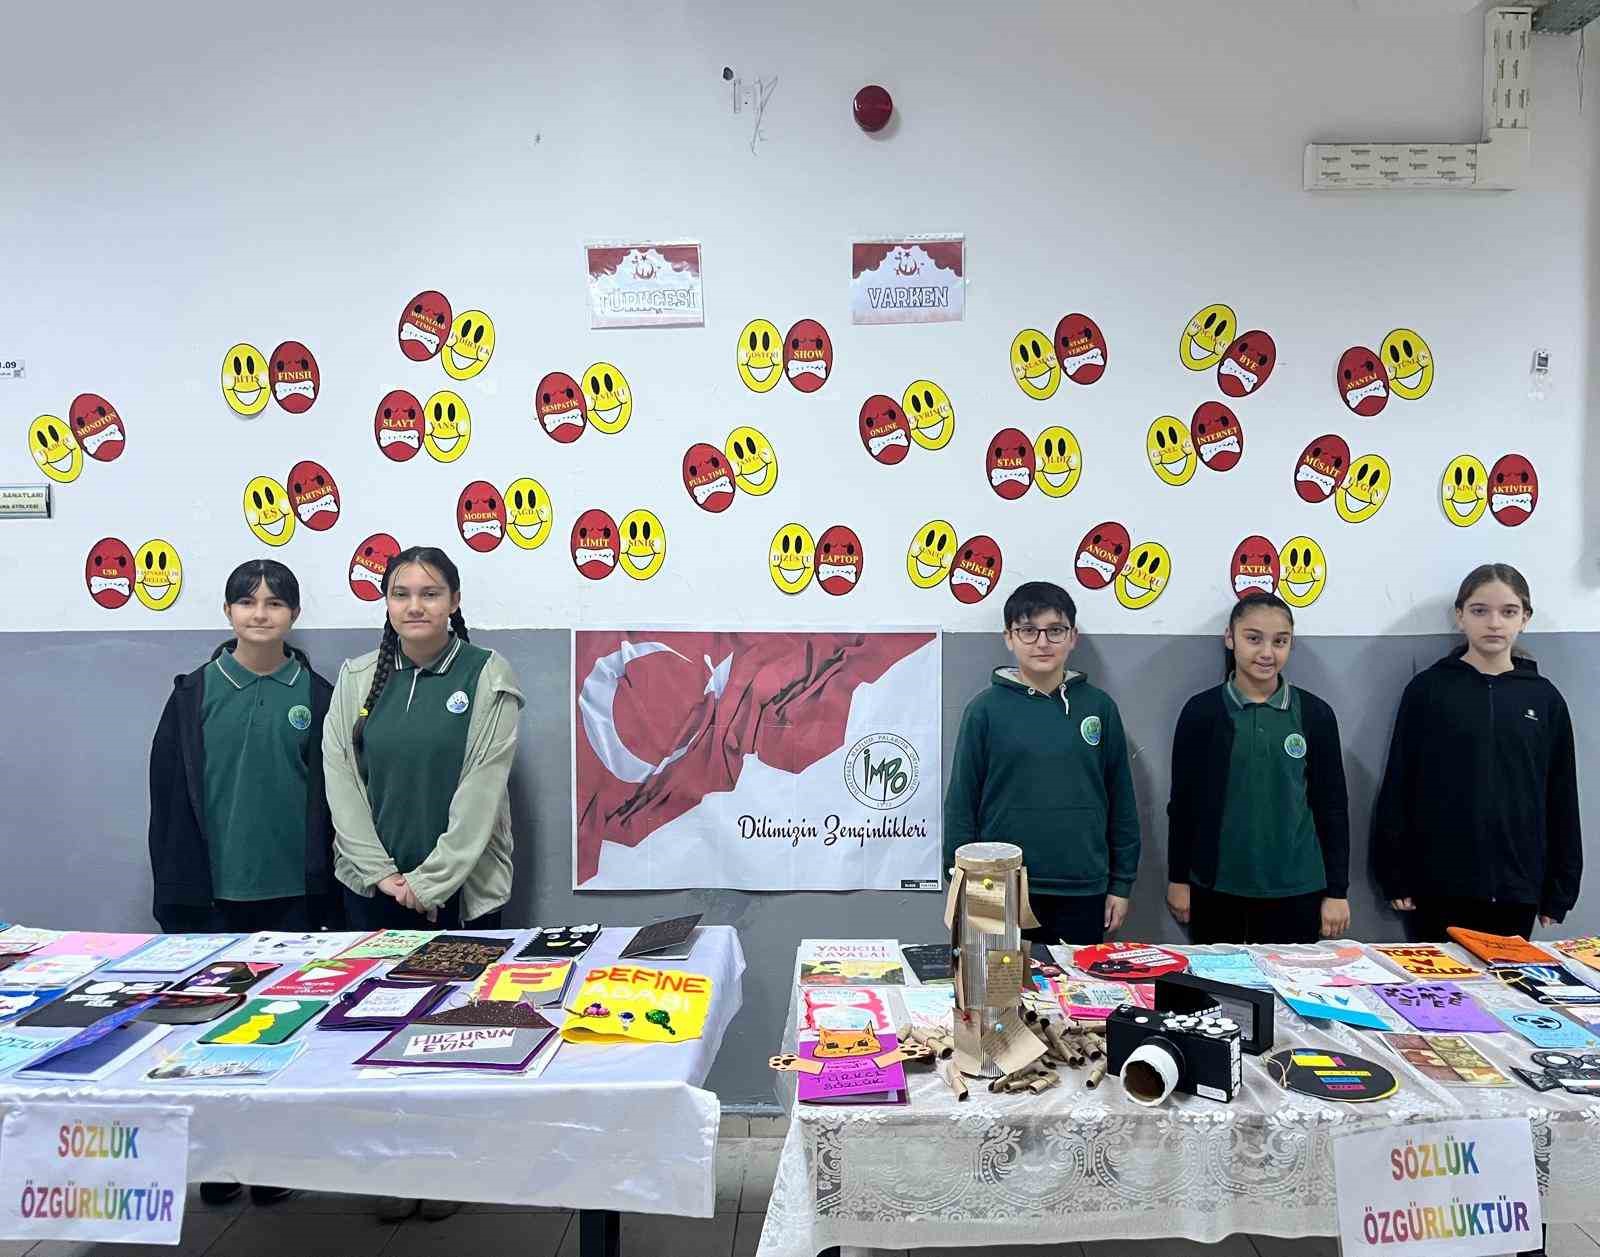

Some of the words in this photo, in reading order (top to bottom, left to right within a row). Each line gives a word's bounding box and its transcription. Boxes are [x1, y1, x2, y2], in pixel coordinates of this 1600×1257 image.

[867, 286, 949, 309] VARKEN
[793, 350, 824, 360] SHOW
[1238, 353, 1265, 371] BYE
[279, 371, 313, 381] FINISH
[77, 412, 118, 437] MONOTON
[385, 418, 417, 430] SLAYT
[869, 422, 899, 438] ONLINE
[997, 458, 1023, 468] STAR
[296, 484, 334, 504] PARTNER
[1493, 483, 1532, 494] AKTİVİTE
[464, 511, 499, 522] MODERN
[579, 537, 611, 548] LİMİT
[820, 554, 860, 564] LAPTOP
[1086, 544, 1120, 565] ANONS
[960, 558, 995, 579] SPİKER
[1238, 565, 1273, 575] EXTRA
[738, 815, 817, 848] Dilimizin
[824, 814, 928, 848] Zenginlikleri
[58, 1120, 139, 1159] SÖZLÜK
[1390, 1136, 1480, 1181] SÖZLÜK
[21, 1180, 174, 1222] ÖZGÜRLÜKTÜR
[1363, 1195, 1530, 1245] ÖZGÜRLÜKTÜR
